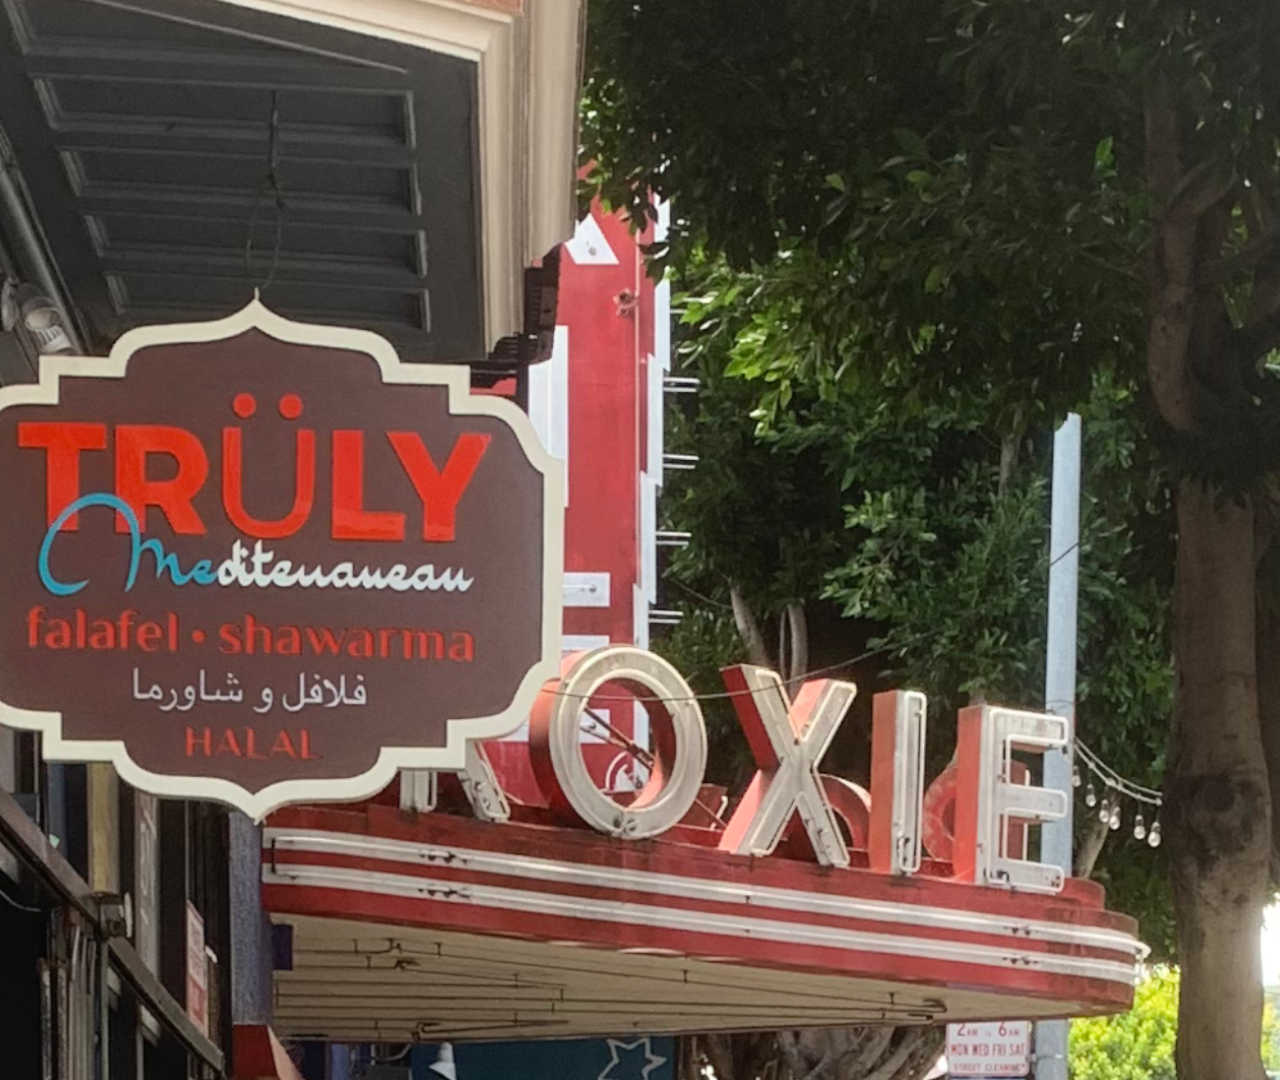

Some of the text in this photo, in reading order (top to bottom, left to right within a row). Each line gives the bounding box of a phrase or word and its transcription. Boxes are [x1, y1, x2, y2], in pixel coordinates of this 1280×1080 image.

[18, 393, 492, 542] TRÜLY
[26, 605, 476, 663] falafel shawarma
[132, 667, 368, 714] فلافل و شاورما
[184, 727, 322, 761] HALAL
[400, 645, 1070, 894] OXIE
[951, 1043, 1025, 1056] MON WED FRI SAT
